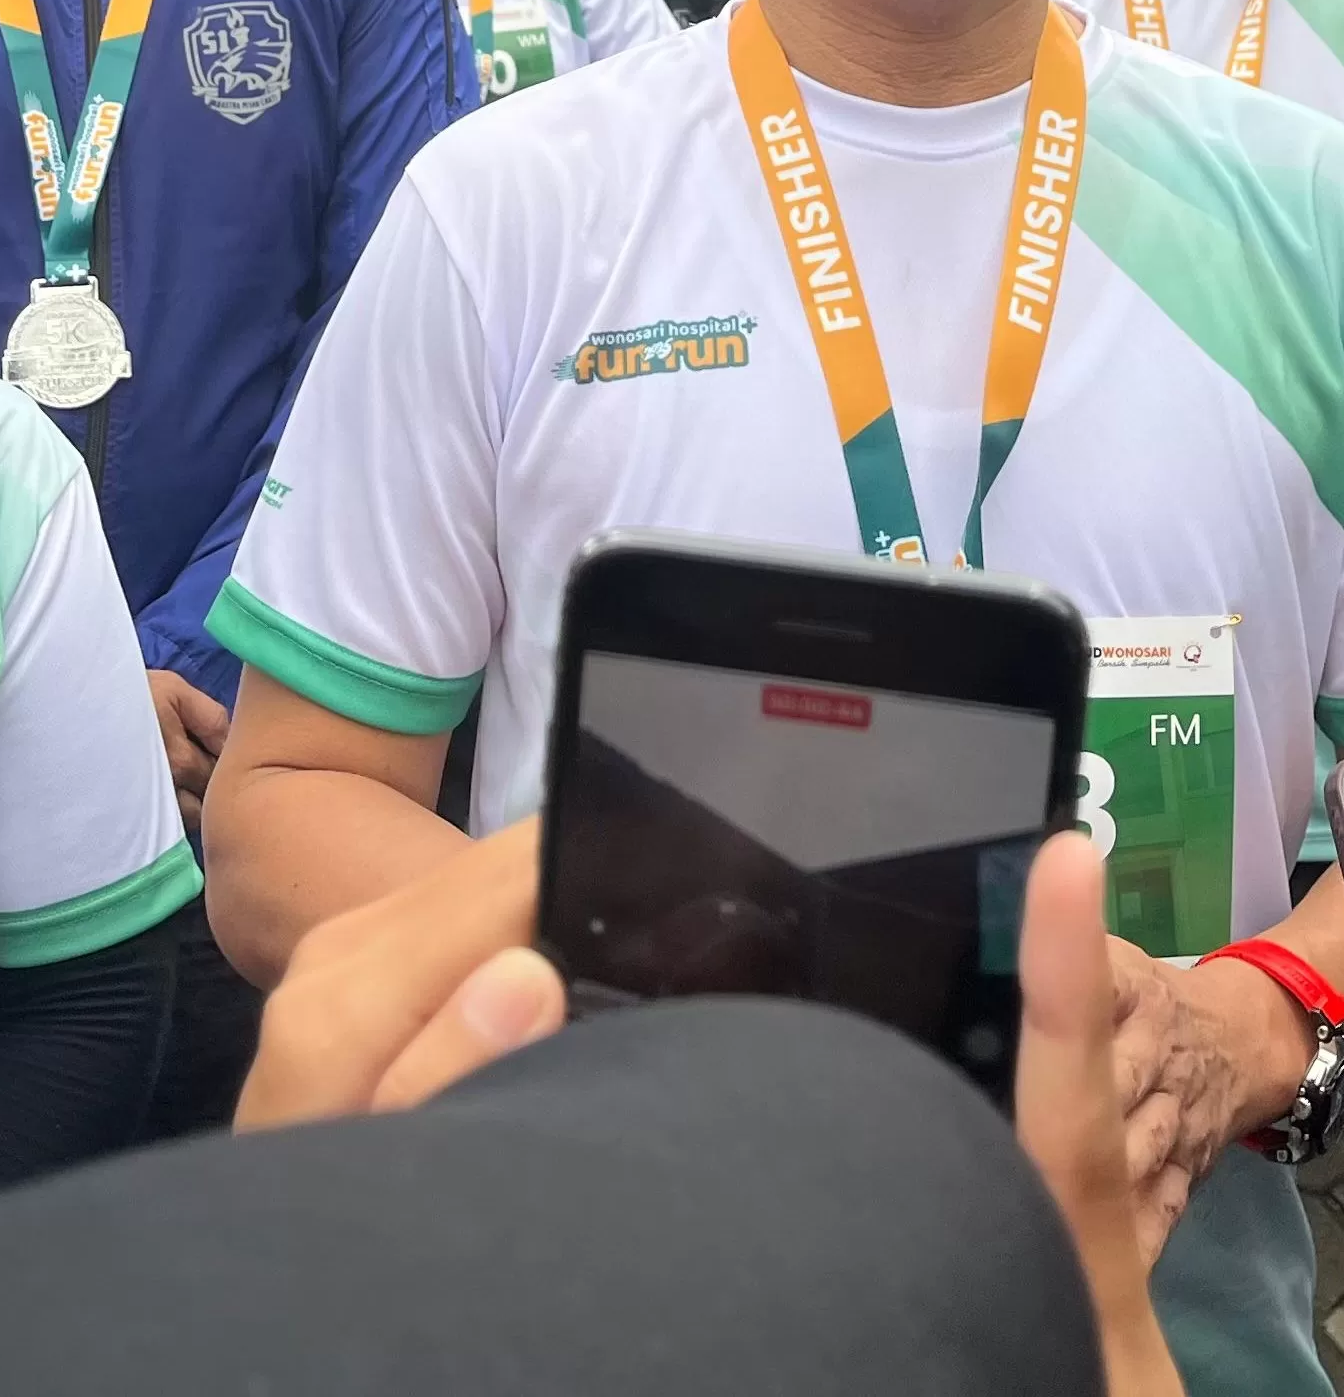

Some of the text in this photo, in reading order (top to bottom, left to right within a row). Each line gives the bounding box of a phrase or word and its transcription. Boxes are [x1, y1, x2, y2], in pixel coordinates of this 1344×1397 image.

[200, 29, 230, 55] 51
[517, 32, 546, 48] WM
[761, 107, 862, 333] FINISHER
[1008, 109, 1078, 334] FINISHER
[591, 318, 737, 346] wonosari hospital
[575, 343, 650, 380] fun
[665, 335, 744, 370] run
[1150, 713, 1201, 747] FM
